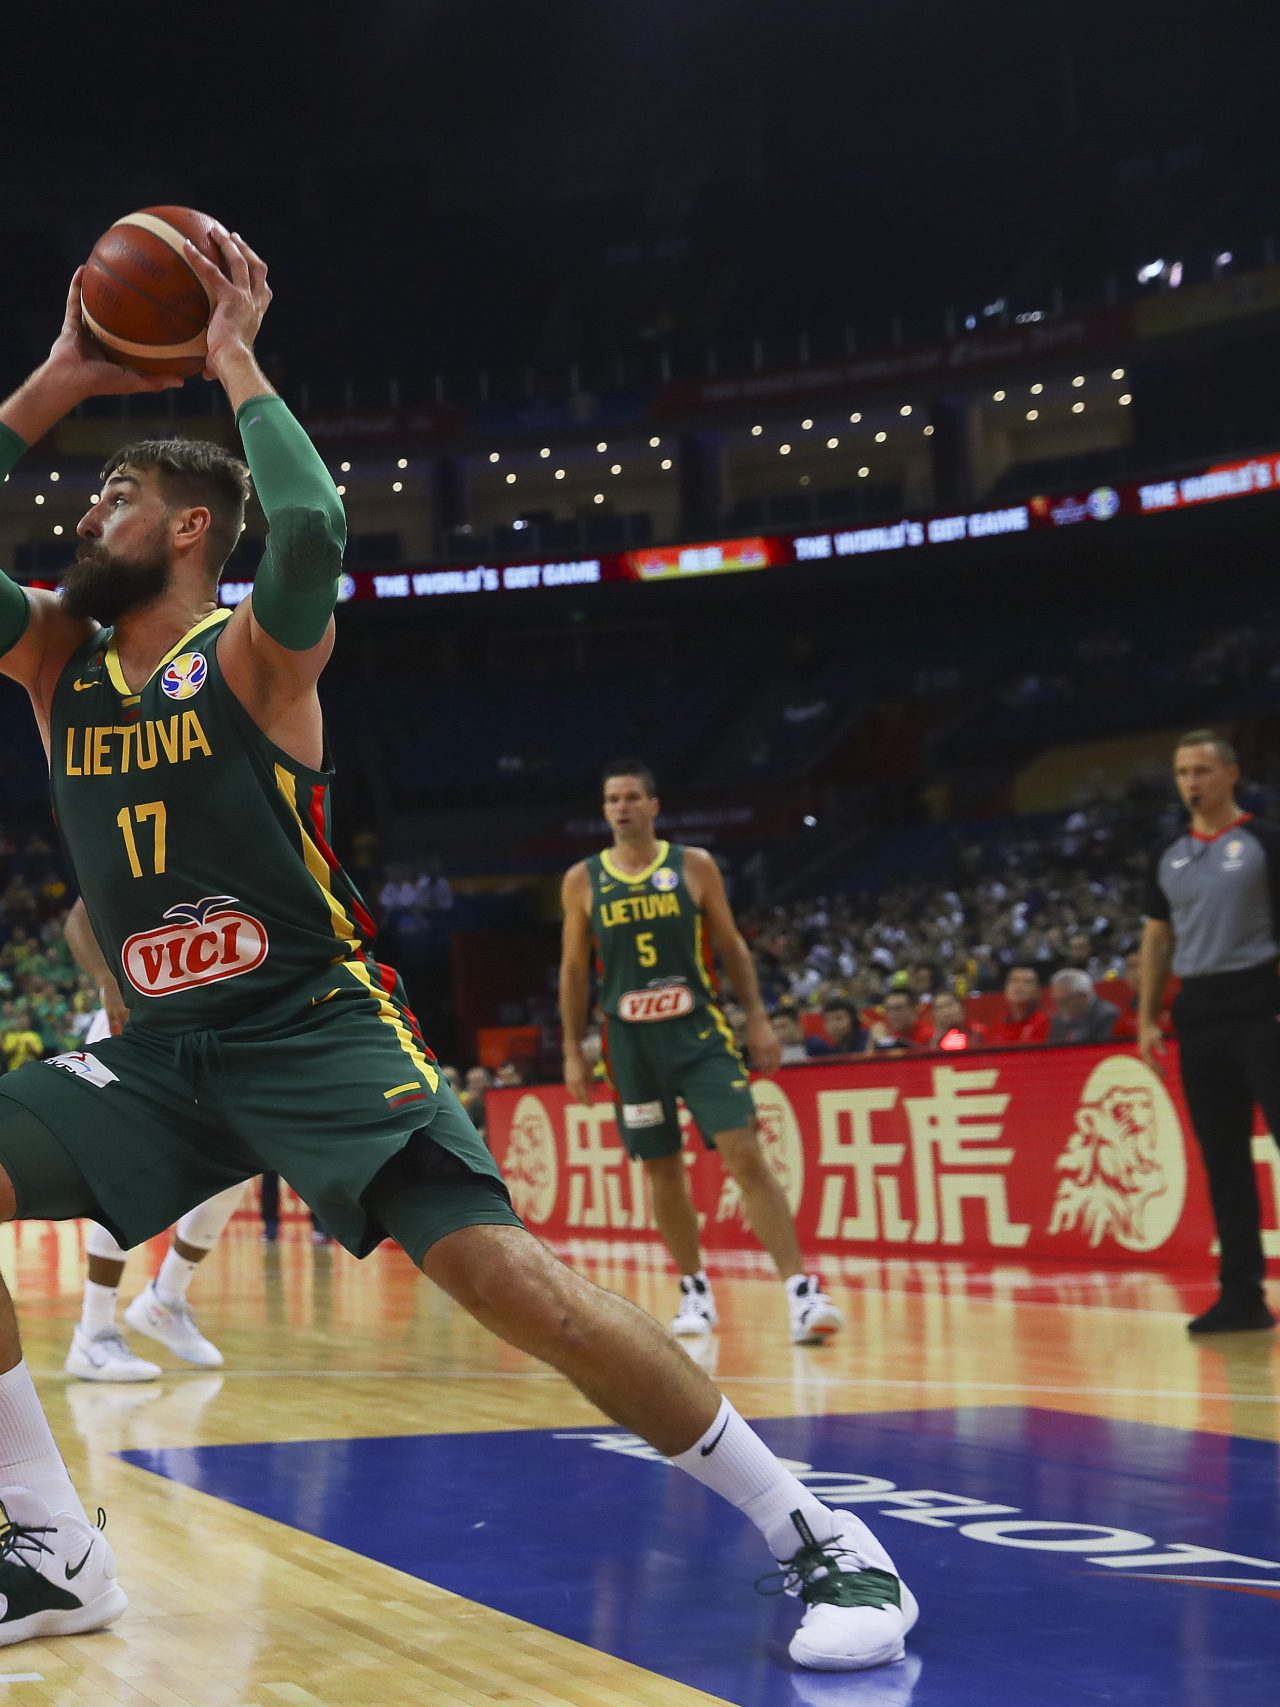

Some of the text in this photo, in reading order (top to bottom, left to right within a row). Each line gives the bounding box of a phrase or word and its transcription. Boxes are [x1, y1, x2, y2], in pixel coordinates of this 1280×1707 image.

[793, 535, 832, 561] THE
[834, 519, 924, 556] WORLD'S
[373, 575, 410, 598] THE
[66, 709, 213, 777] LIETUVA
[116, 800, 168, 878] 17
[600, 892, 681, 928] LIETUVA
[138, 926, 241, 986] VICI
[636, 932, 658, 968] 5
[629, 991, 682, 1016] VICI
[816, 1066, 1032, 1247] 乐虎
[551, 1433, 1280, 1570] OFLOT
